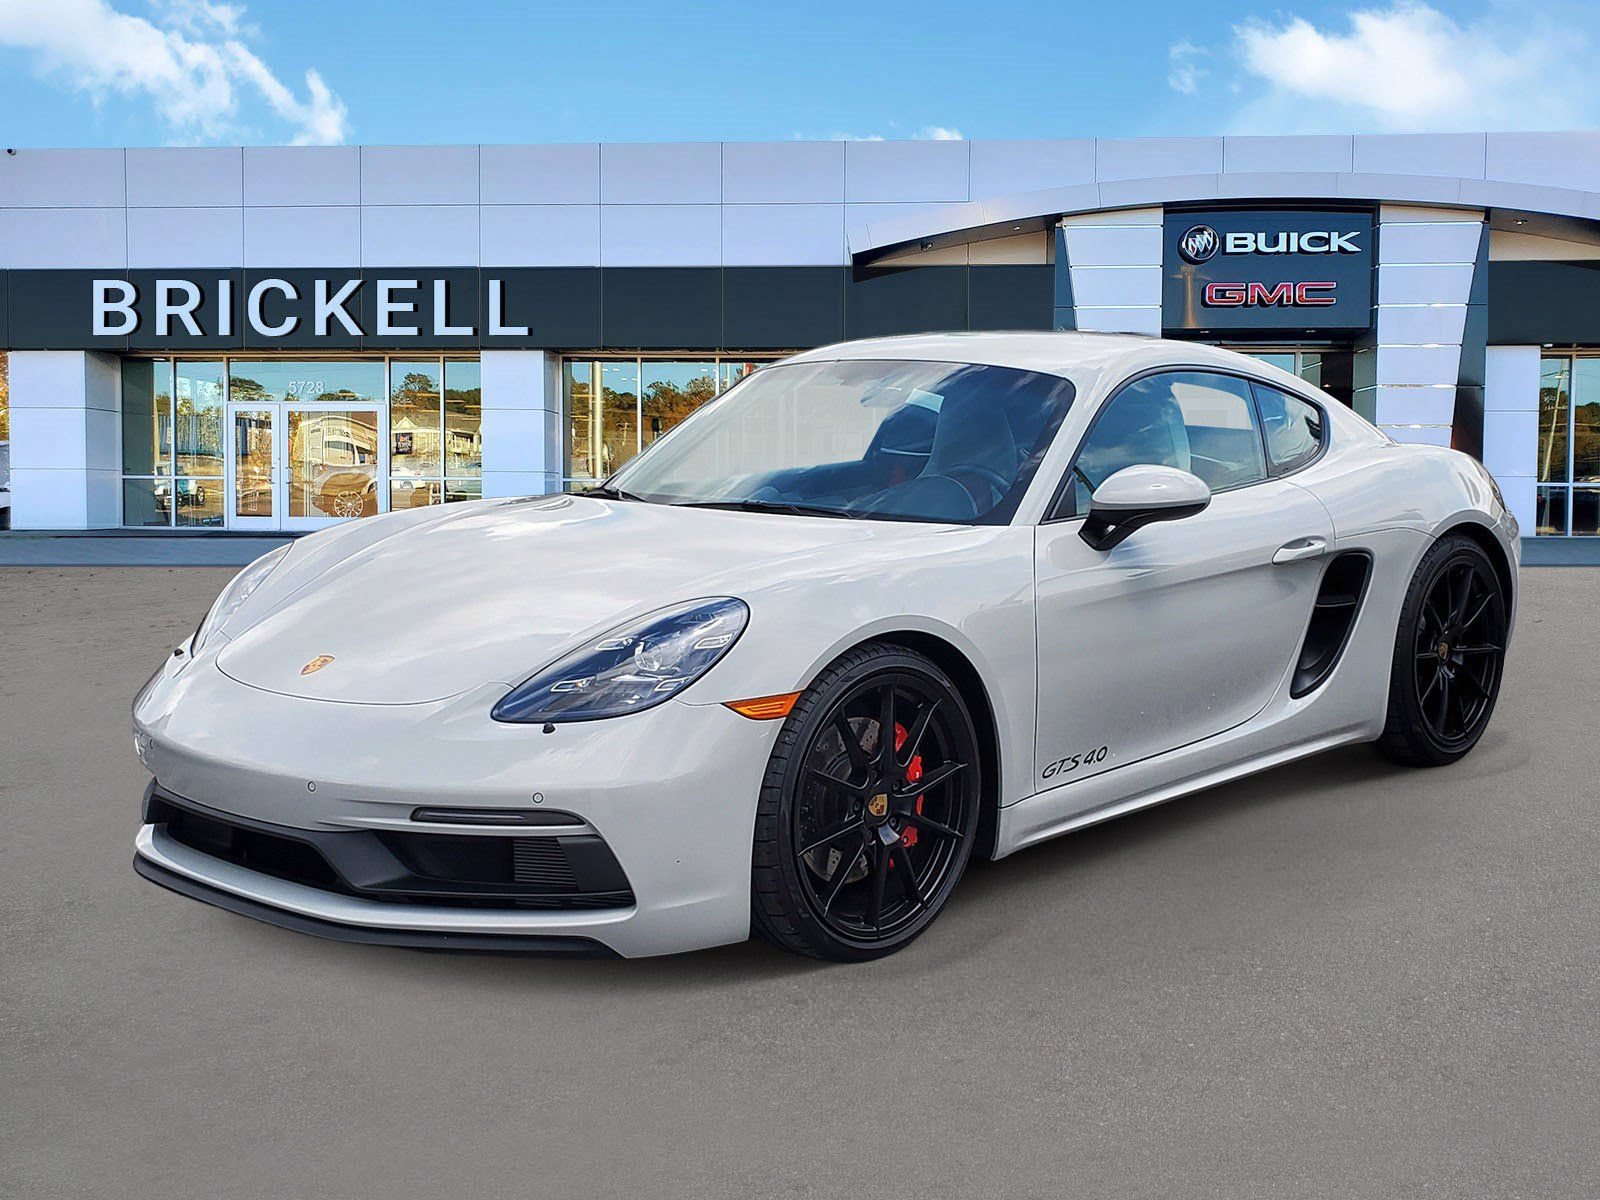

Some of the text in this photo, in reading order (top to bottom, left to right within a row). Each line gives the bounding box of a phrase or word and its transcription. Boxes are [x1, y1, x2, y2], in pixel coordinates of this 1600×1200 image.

[1225, 231, 1362, 253] BUICK
[1205, 281, 1337, 306] GMC
[91, 279, 532, 337] BRICKELL
[288, 381, 324, 394] 5728
[1042, 746, 1108, 779] GTS 4.0
